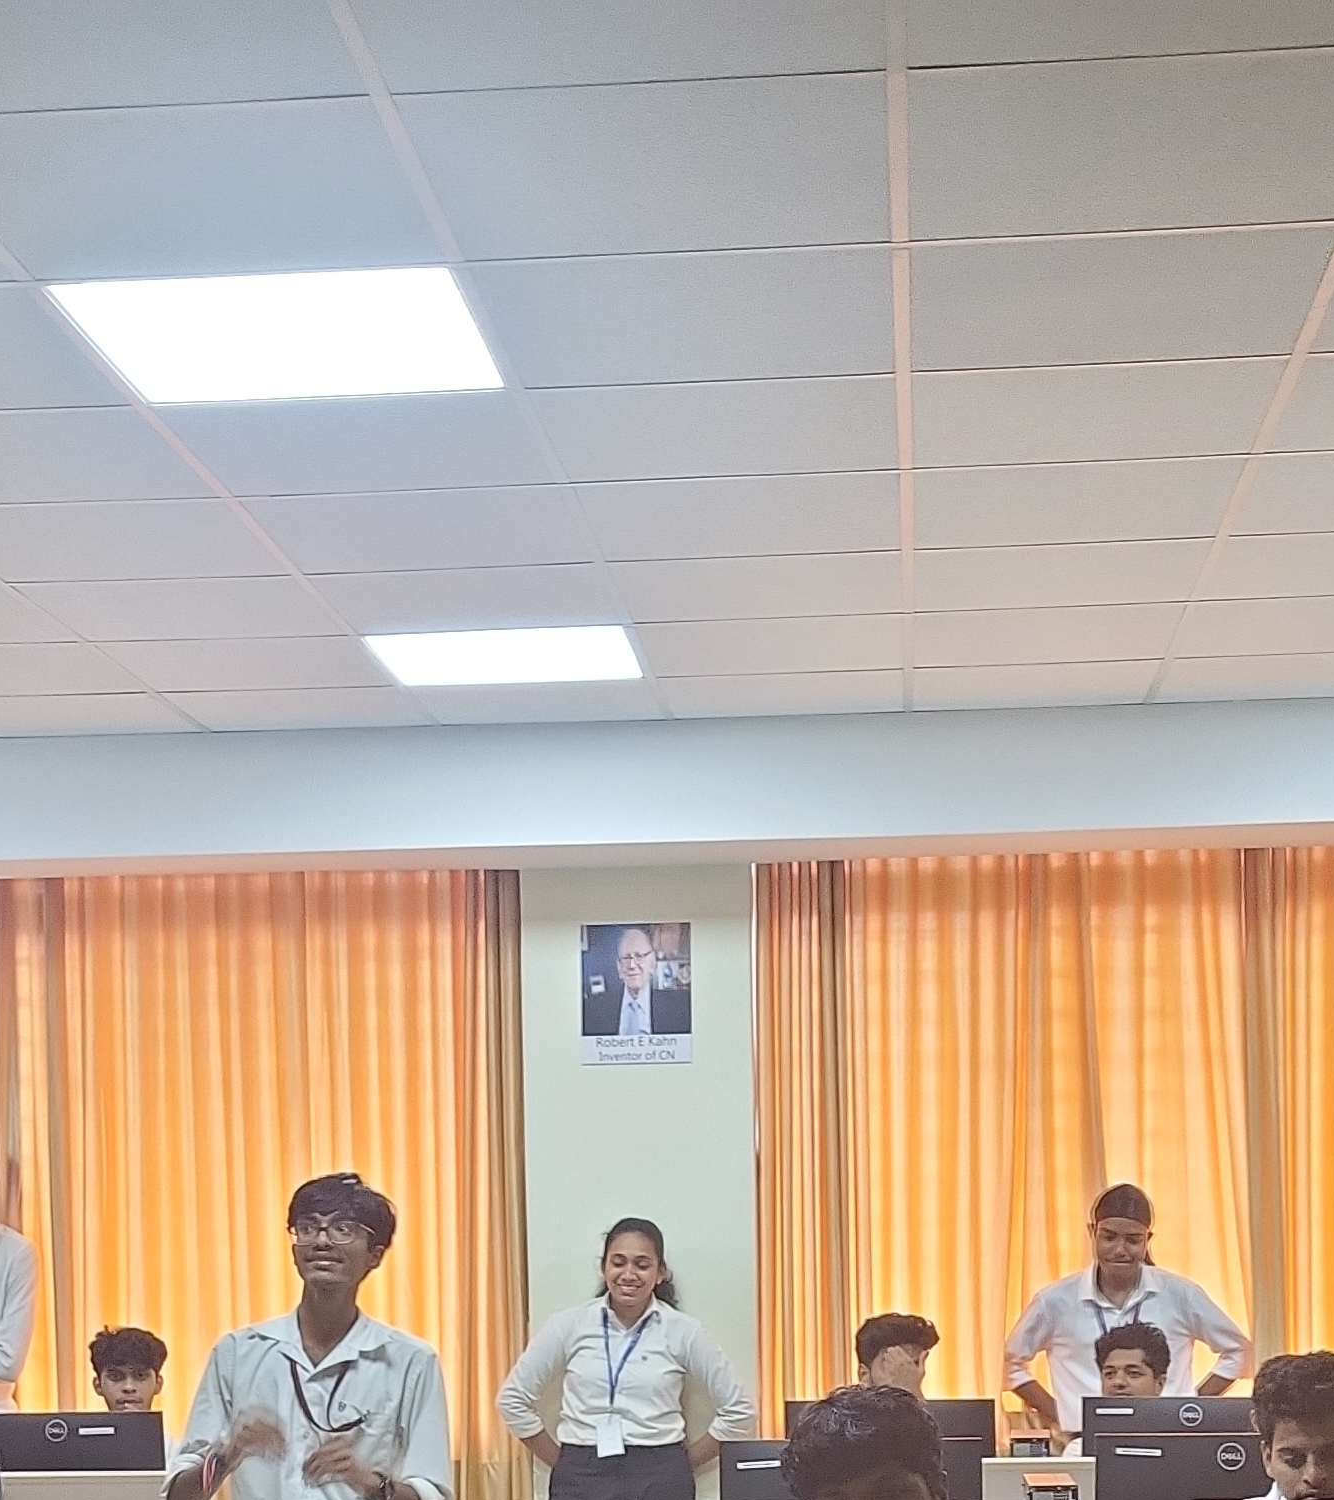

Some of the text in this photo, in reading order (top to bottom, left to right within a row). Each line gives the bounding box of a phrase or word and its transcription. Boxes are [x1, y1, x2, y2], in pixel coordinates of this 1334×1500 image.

[596, 1036, 677, 1047] Robert E Kahn
[598, 1050, 675, 1061] Inventor of CN
